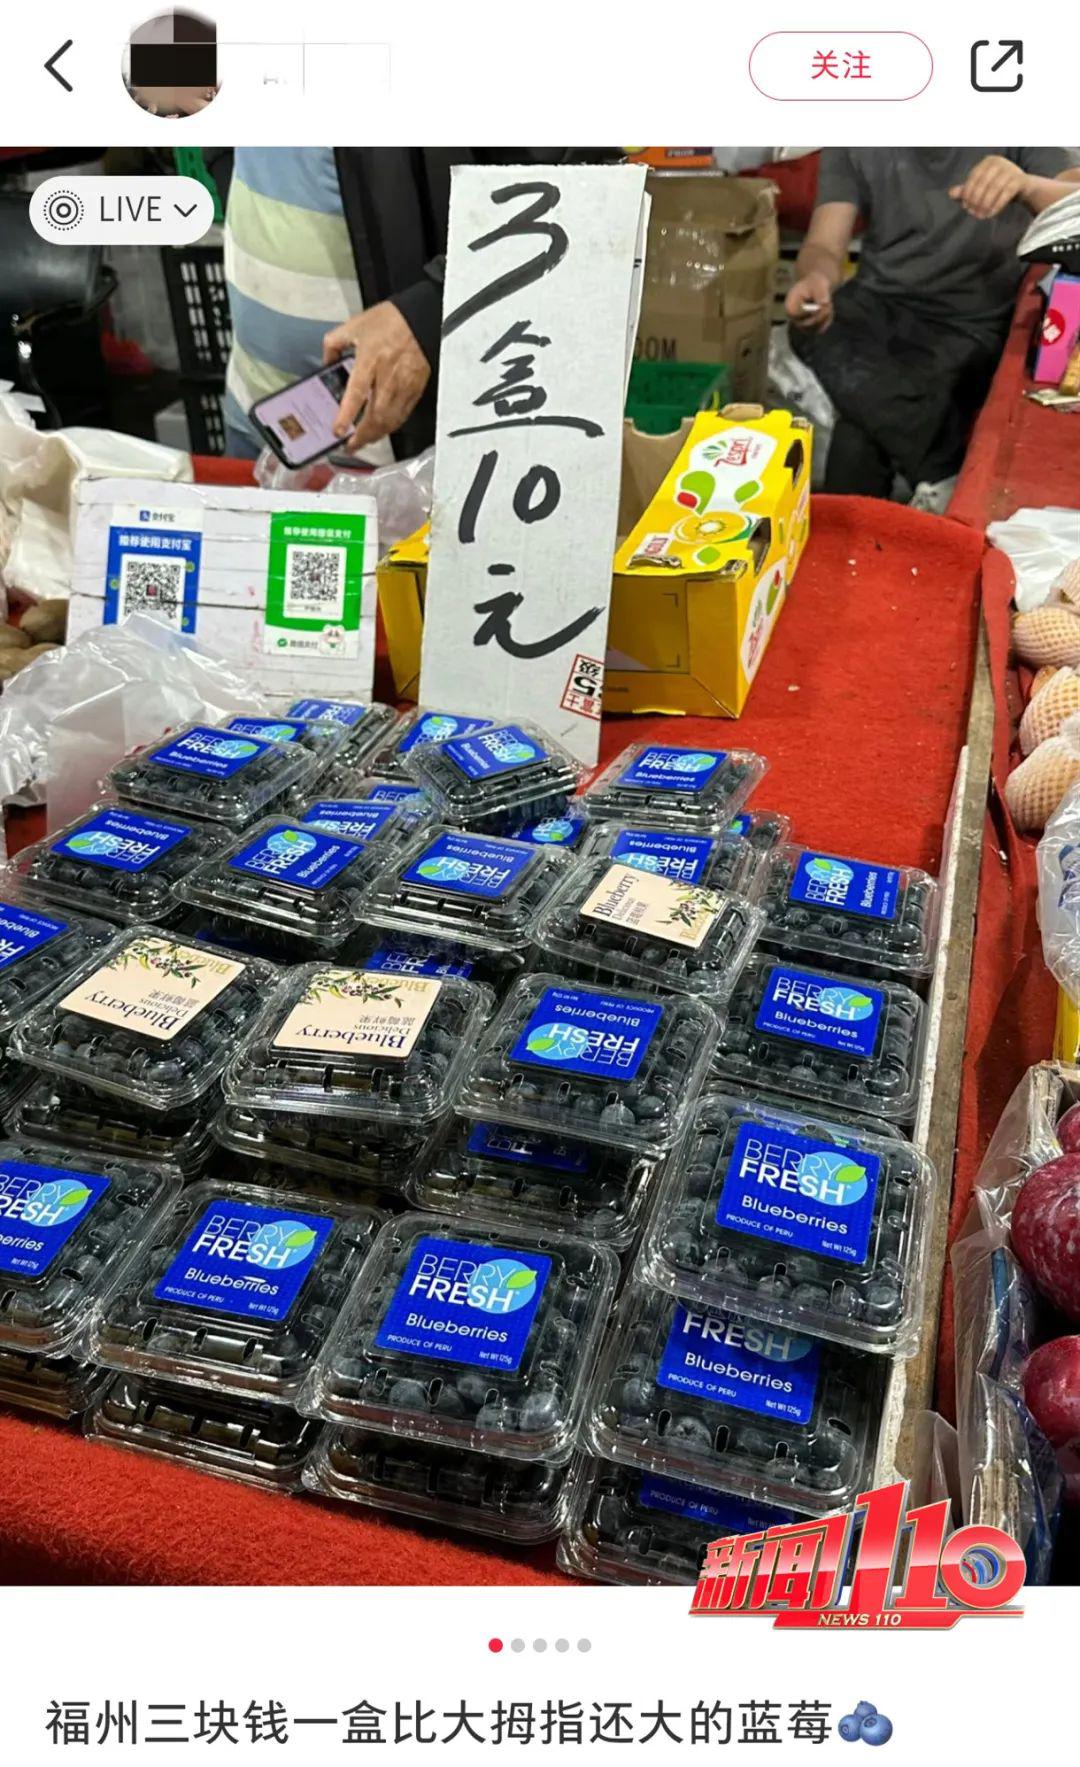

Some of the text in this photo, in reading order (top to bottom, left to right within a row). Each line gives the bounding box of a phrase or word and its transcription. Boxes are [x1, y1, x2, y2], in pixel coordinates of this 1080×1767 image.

[118, 533, 193, 551] 推荐使用支付宝
[88, 831, 161, 856] FRESH
[104, 819, 170, 841] Blueberries
[263, 839, 314, 875] FRESH
[445, 843, 515, 864] Blueberries
[627, 853, 699, 869] FRESH
[629, 840, 697, 853] Blueberries
[436, 856, 512, 879] FRESH
[593, 872, 642, 918] Blueberry
[825, 868, 852, 906] FRESH
[776, 976, 853, 1003] BERRY
[85, 991, 183, 1032] Blueberry
[554, 1004, 641, 1027] Blueberries
[772, 988, 857, 1021] FRESH
[296, 1025, 409, 1050] Blueberry
[353, 1023, 411, 1036] Delicious
[549, 1023, 641, 1054] FRESH
[774, 1010, 858, 1039] Blueberries
[557, 1041, 634, 1068] BERRY
[744, 1138, 843, 1180] BERRY
[739, 1158, 846, 1205] FRESH
[726, 1213, 761, 1229] PRODUCE
[763, 1223, 775, 1232] OF
[741, 1194, 849, 1235] Blueberries
[204, 1214, 297, 1247] BERRY
[191, 1233, 294, 1267] FRESH
[184, 1267, 280, 1296] Blueberries
[417, 1253, 517, 1290] BERRY
[408, 1274, 515, 1313] FRESH
[387, 1334, 421, 1348] PRODUCE
[423, 1342, 434, 1350] OF
[406, 1312, 509, 1344] Blueberries
[682, 1310, 793, 1361] FRESH
[667, 1372, 737, 1399] PRODUCE OF PERU
[684, 1351, 794, 1394] Blueberries
